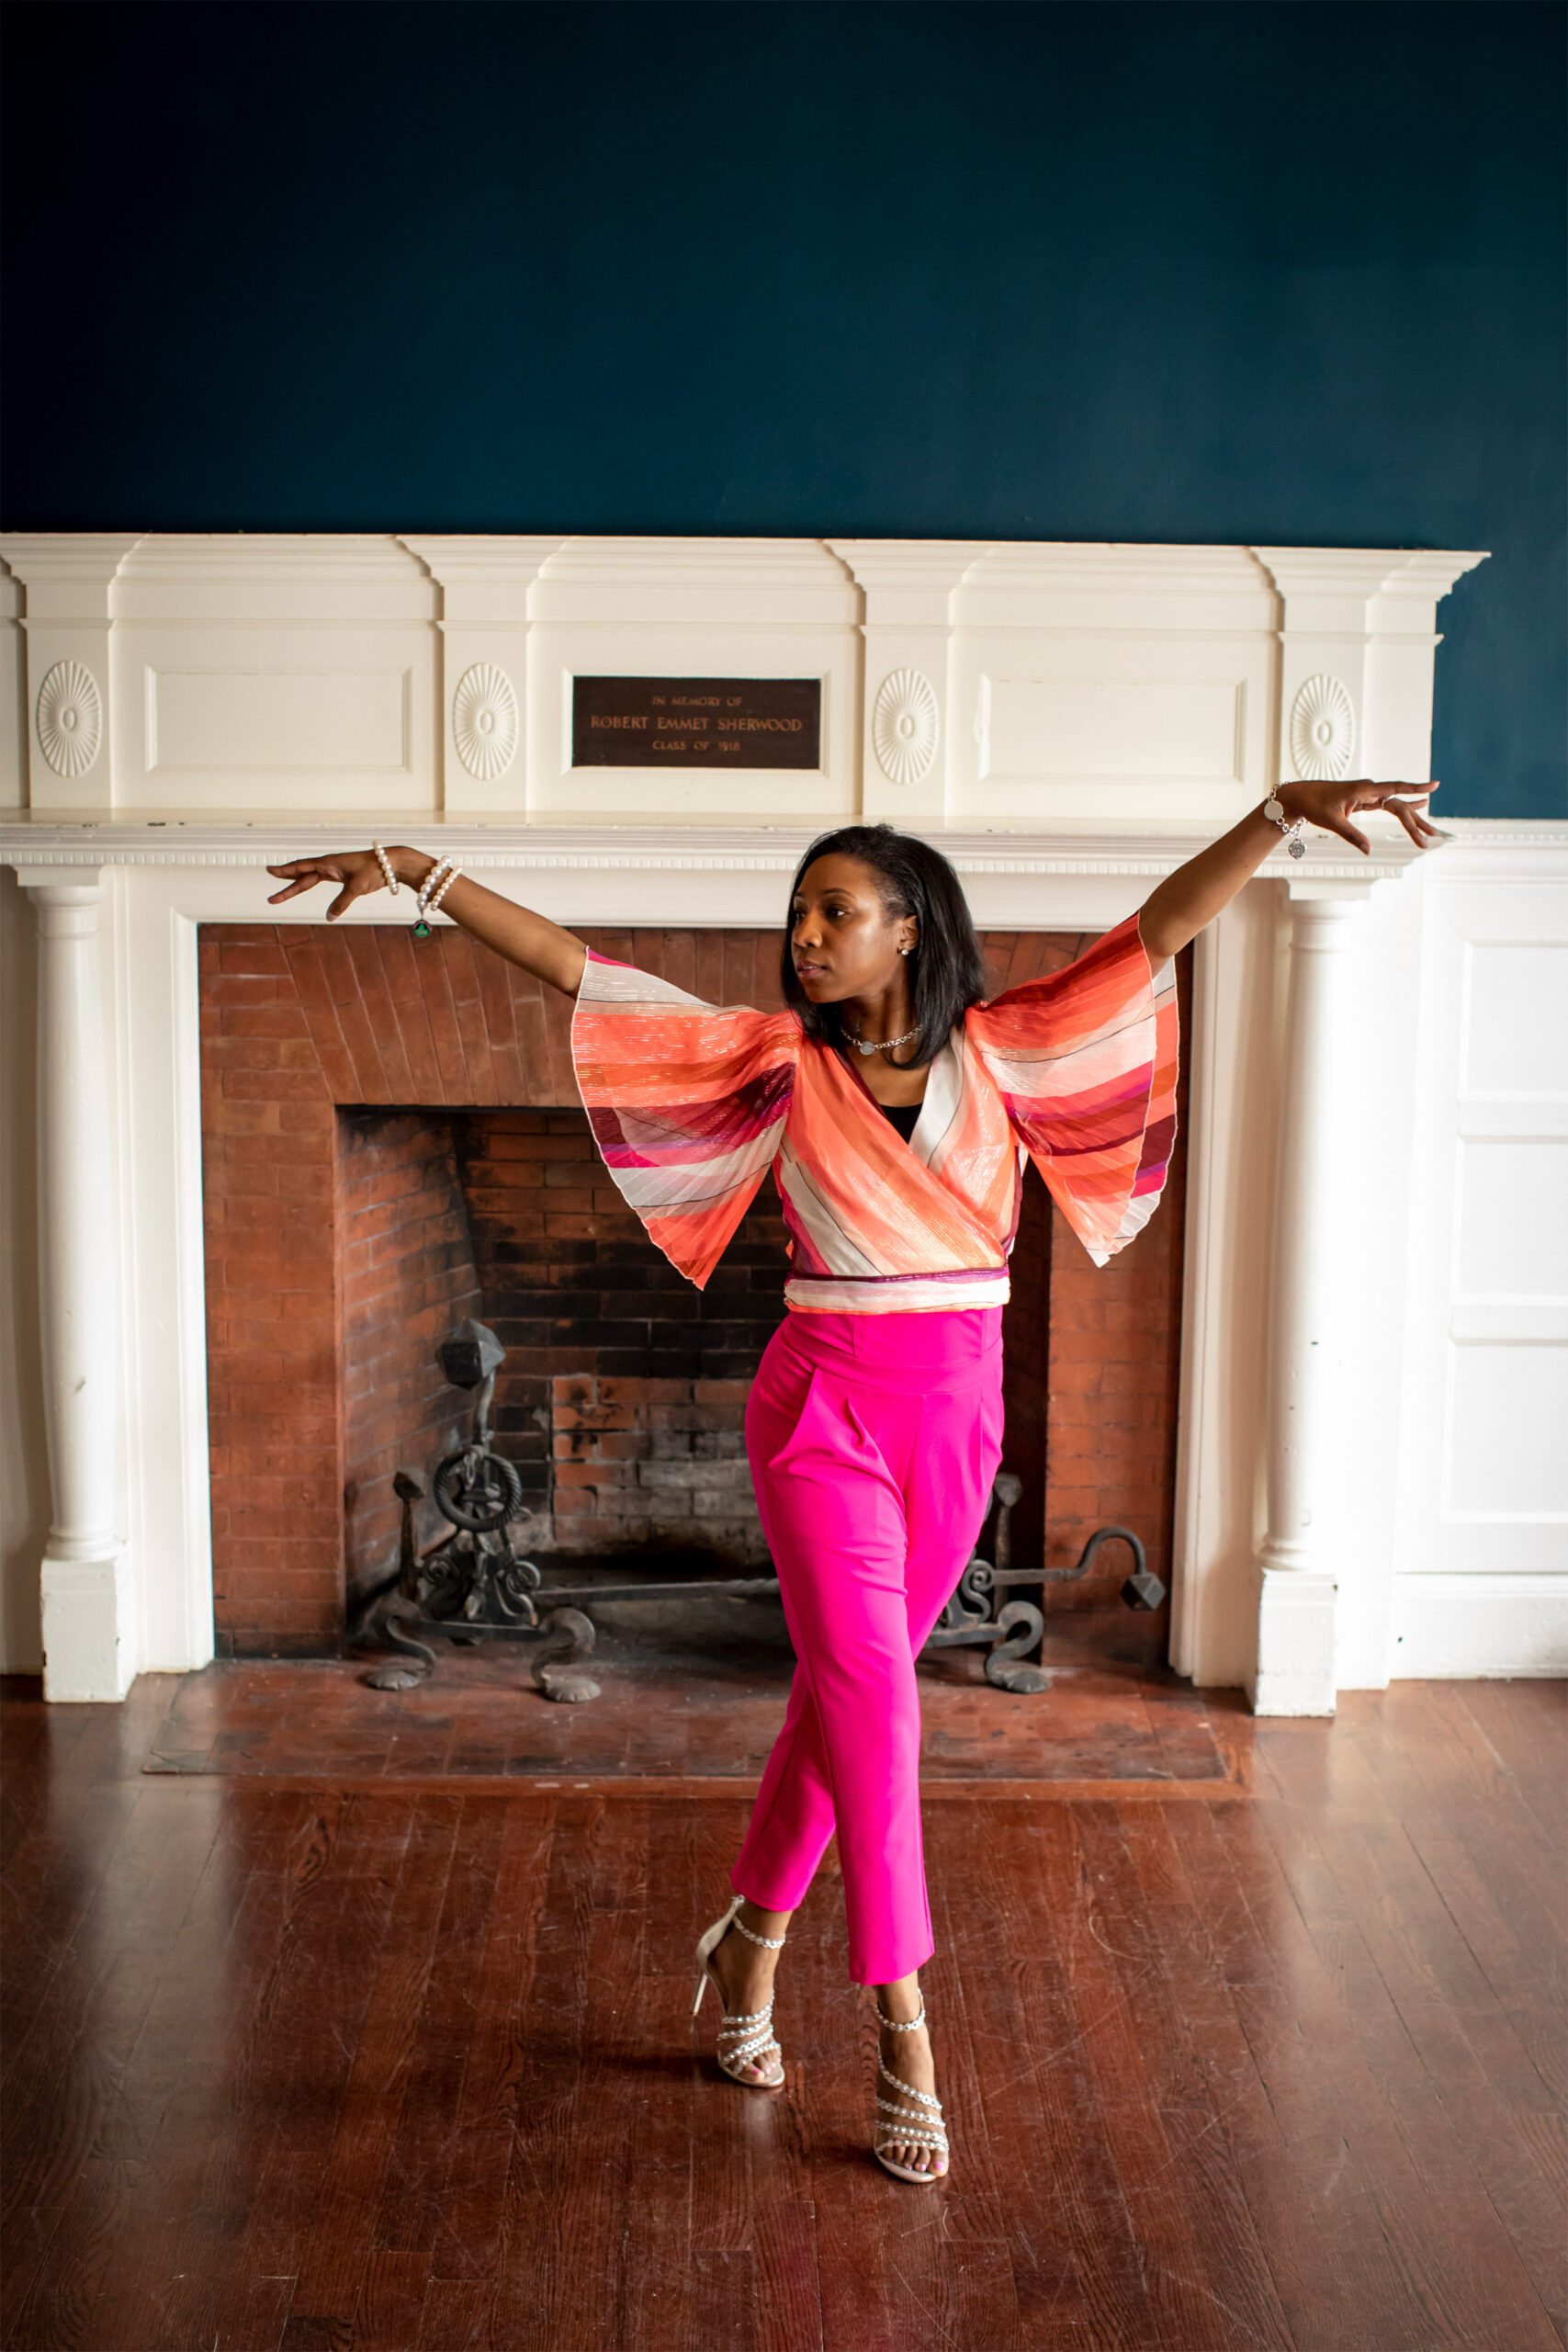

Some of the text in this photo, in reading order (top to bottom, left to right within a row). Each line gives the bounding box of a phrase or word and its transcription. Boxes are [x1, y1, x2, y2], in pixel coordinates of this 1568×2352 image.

[653, 696, 743, 707] IN MEMORY OF
[591, 716, 803, 732] ROBERT EMMET SHERWOOD
[652, 741, 686, 751] CLASS
[694, 741, 710, 751] OF
